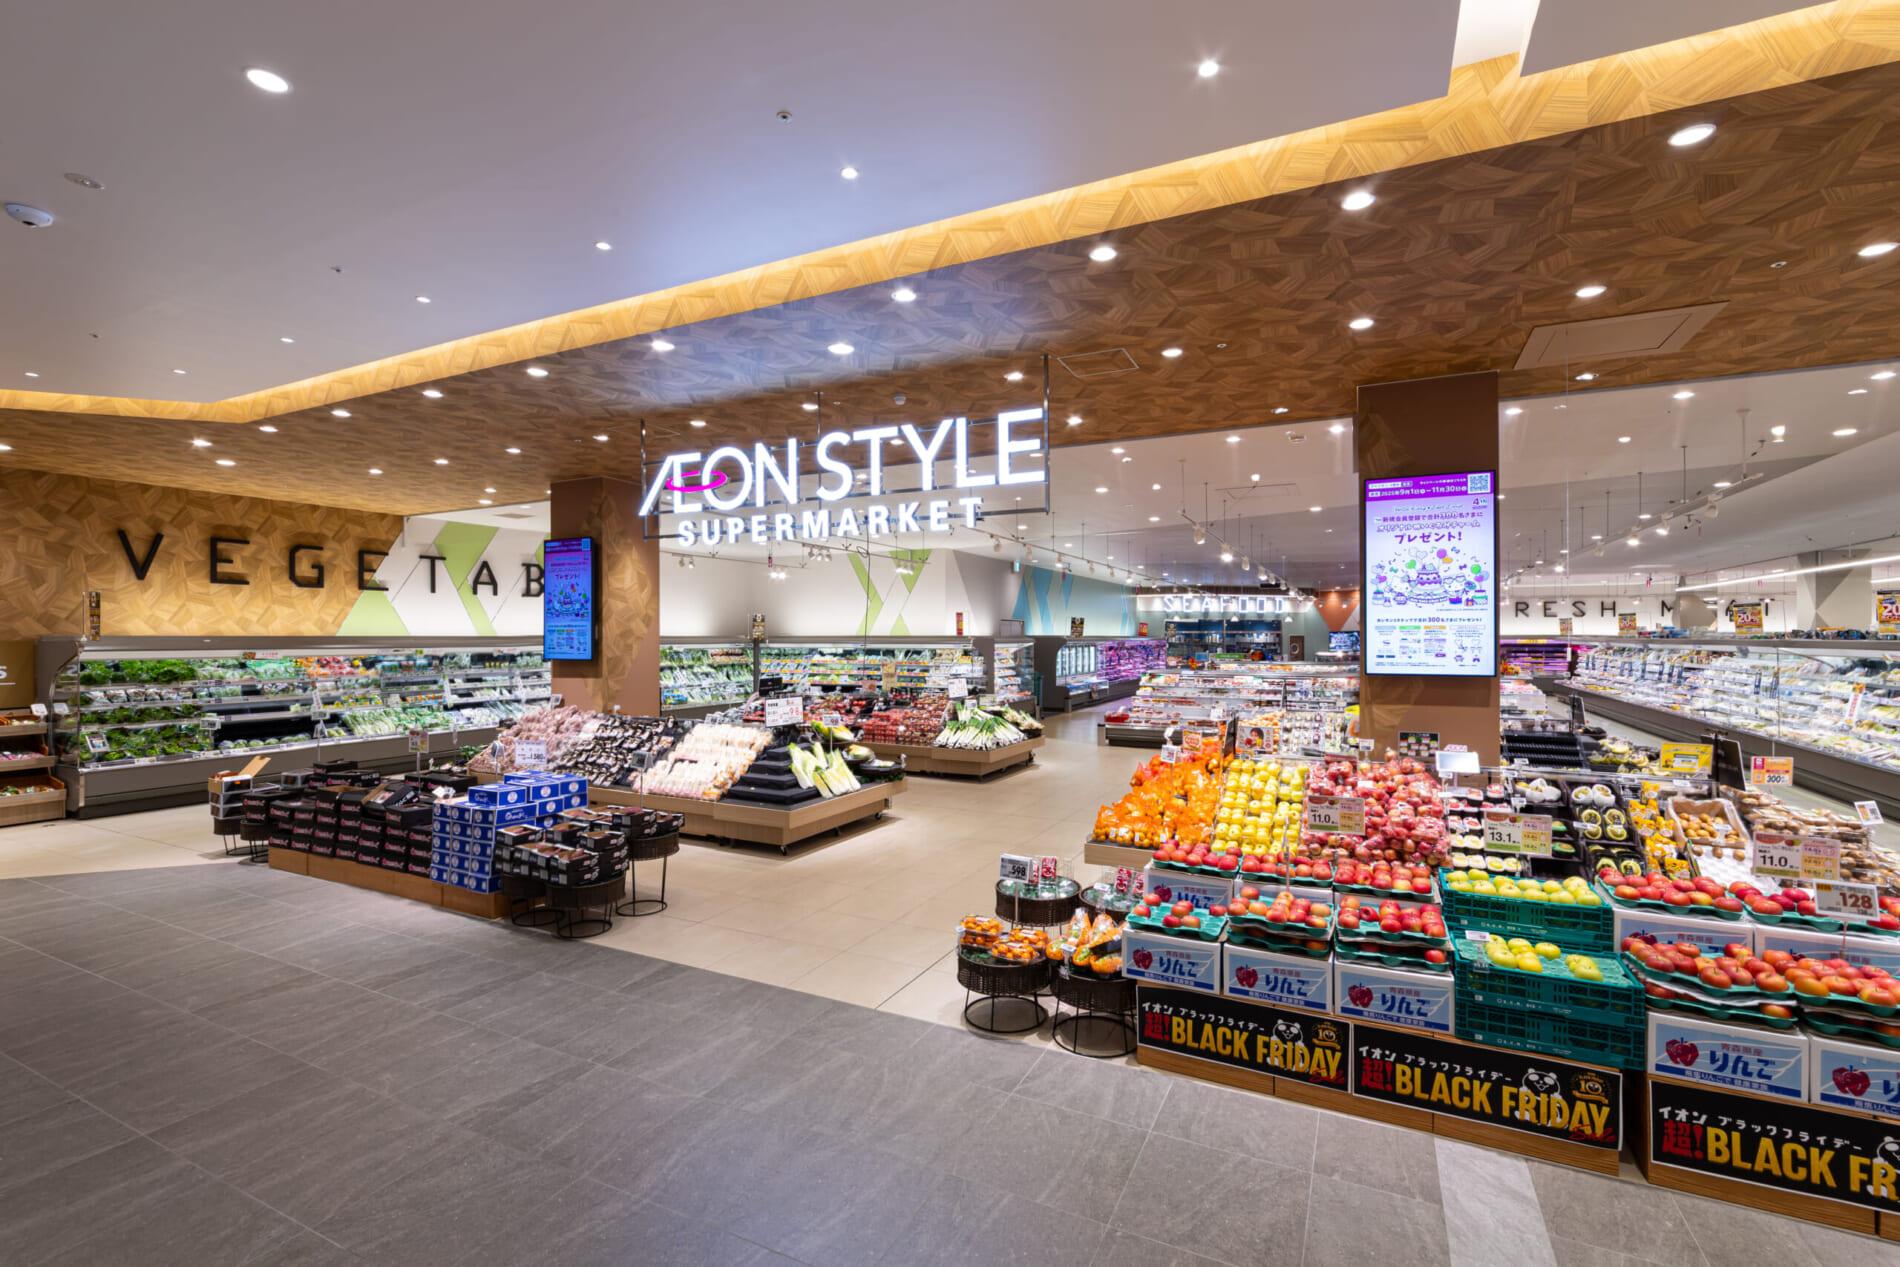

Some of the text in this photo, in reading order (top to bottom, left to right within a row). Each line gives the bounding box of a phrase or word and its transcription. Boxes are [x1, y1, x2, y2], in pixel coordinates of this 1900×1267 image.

[815, 407, 1045, 501] STYLE
[678, 496, 984, 547] SUPERMARKET
[1163, 595, 1285, 614] SEAFOOD
[1489, 831, 1512, 843] 13.1
[1760, 854, 1788, 868] 11.0
[1840, 892, 1873, 909] 128
[1159, 956, 1199, 978] りんご
[1265, 974, 1309, 997] りんご
[1142, 1001, 1265, 1031] イオン ブラックフライデー
[1381, 993, 1430, 1017] りんご
[1171, 1016, 1249, 1061] BLACK
[1256, 1034, 1342, 1079] FRIDAY
[1358, 1045, 1512, 1082] イオン ブラックフライデー
[1709, 1050, 1776, 1081] りんご
[1395, 1063, 1493, 1114] BLACK
[1502, 1084, 1610, 1138] FRIDAY
[1658, 1106, 1863, 1151] イオン ブラックフライデー
[1706, 1126, 1837, 1189] BLACK
